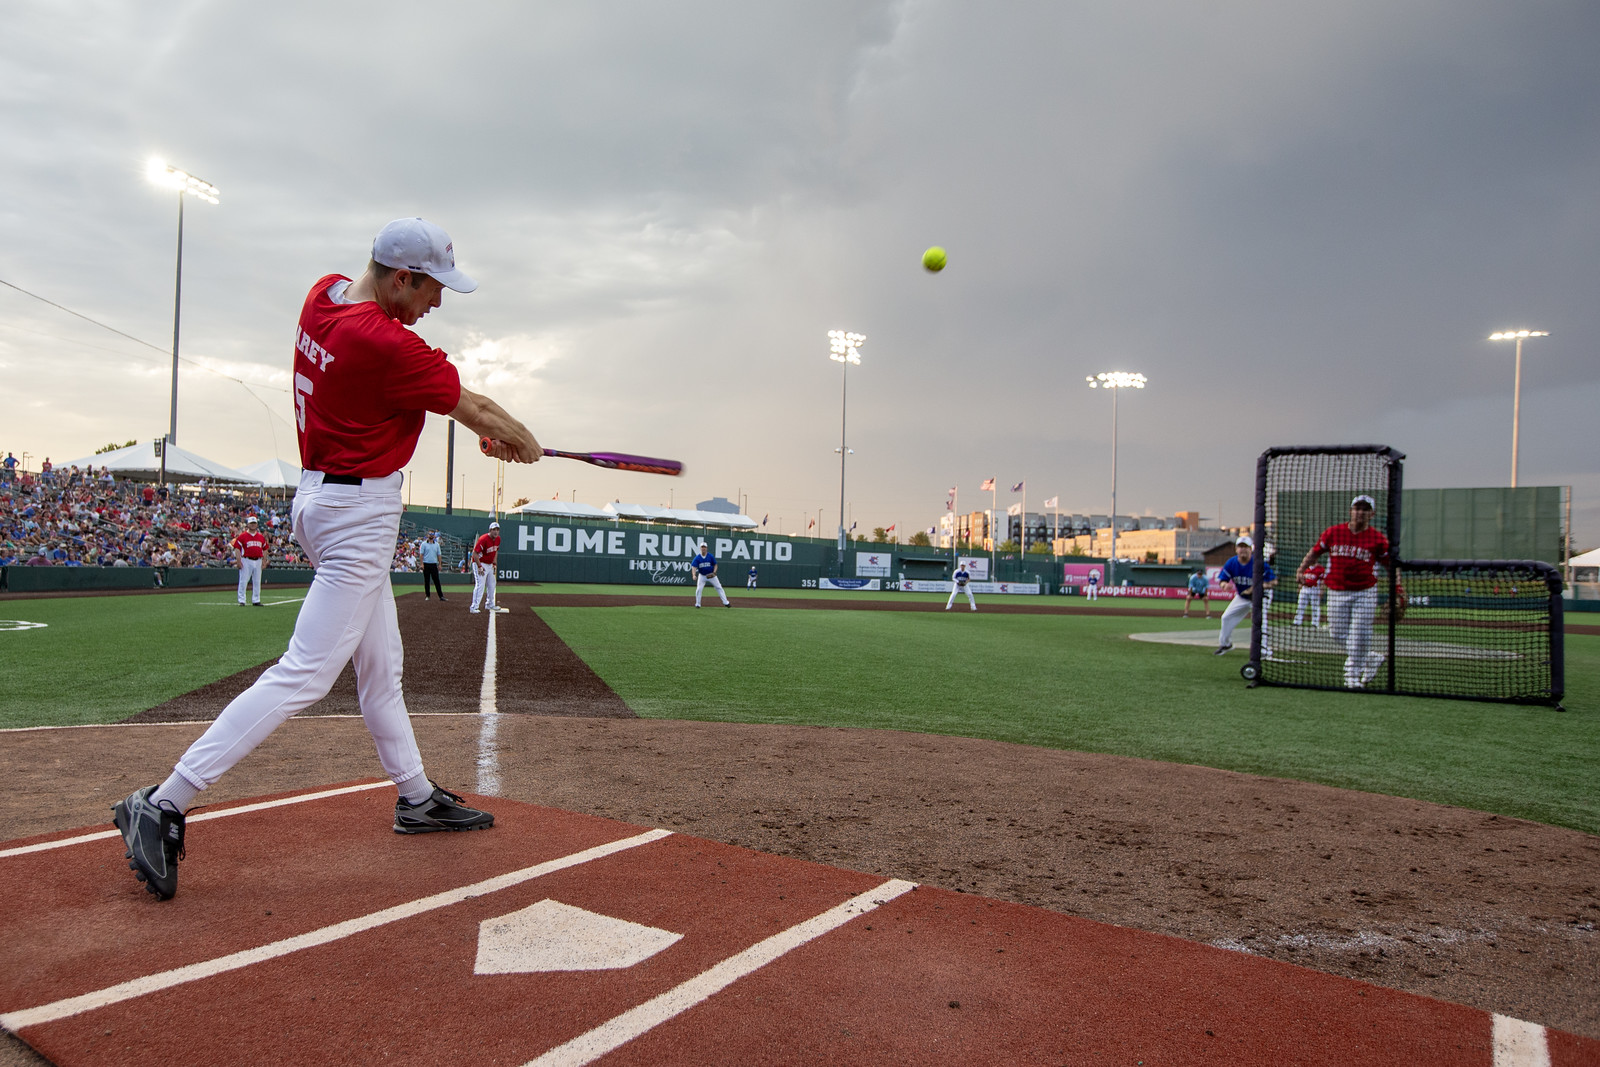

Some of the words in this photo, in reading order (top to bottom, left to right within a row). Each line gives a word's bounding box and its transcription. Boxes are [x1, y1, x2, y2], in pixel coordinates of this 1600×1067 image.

[518, 525, 626, 555] HOME
[638, 532, 705, 558] RUN
[715, 538, 793, 561] PATIO
[629, 559, 698, 572] HOLLYWO
[499, 570, 520, 579] 300
[649, 567, 687, 584] Casino
[801, 579, 817, 588] 352
[886, 581, 900, 590] 347
[1059, 586, 1072, 595] 411
